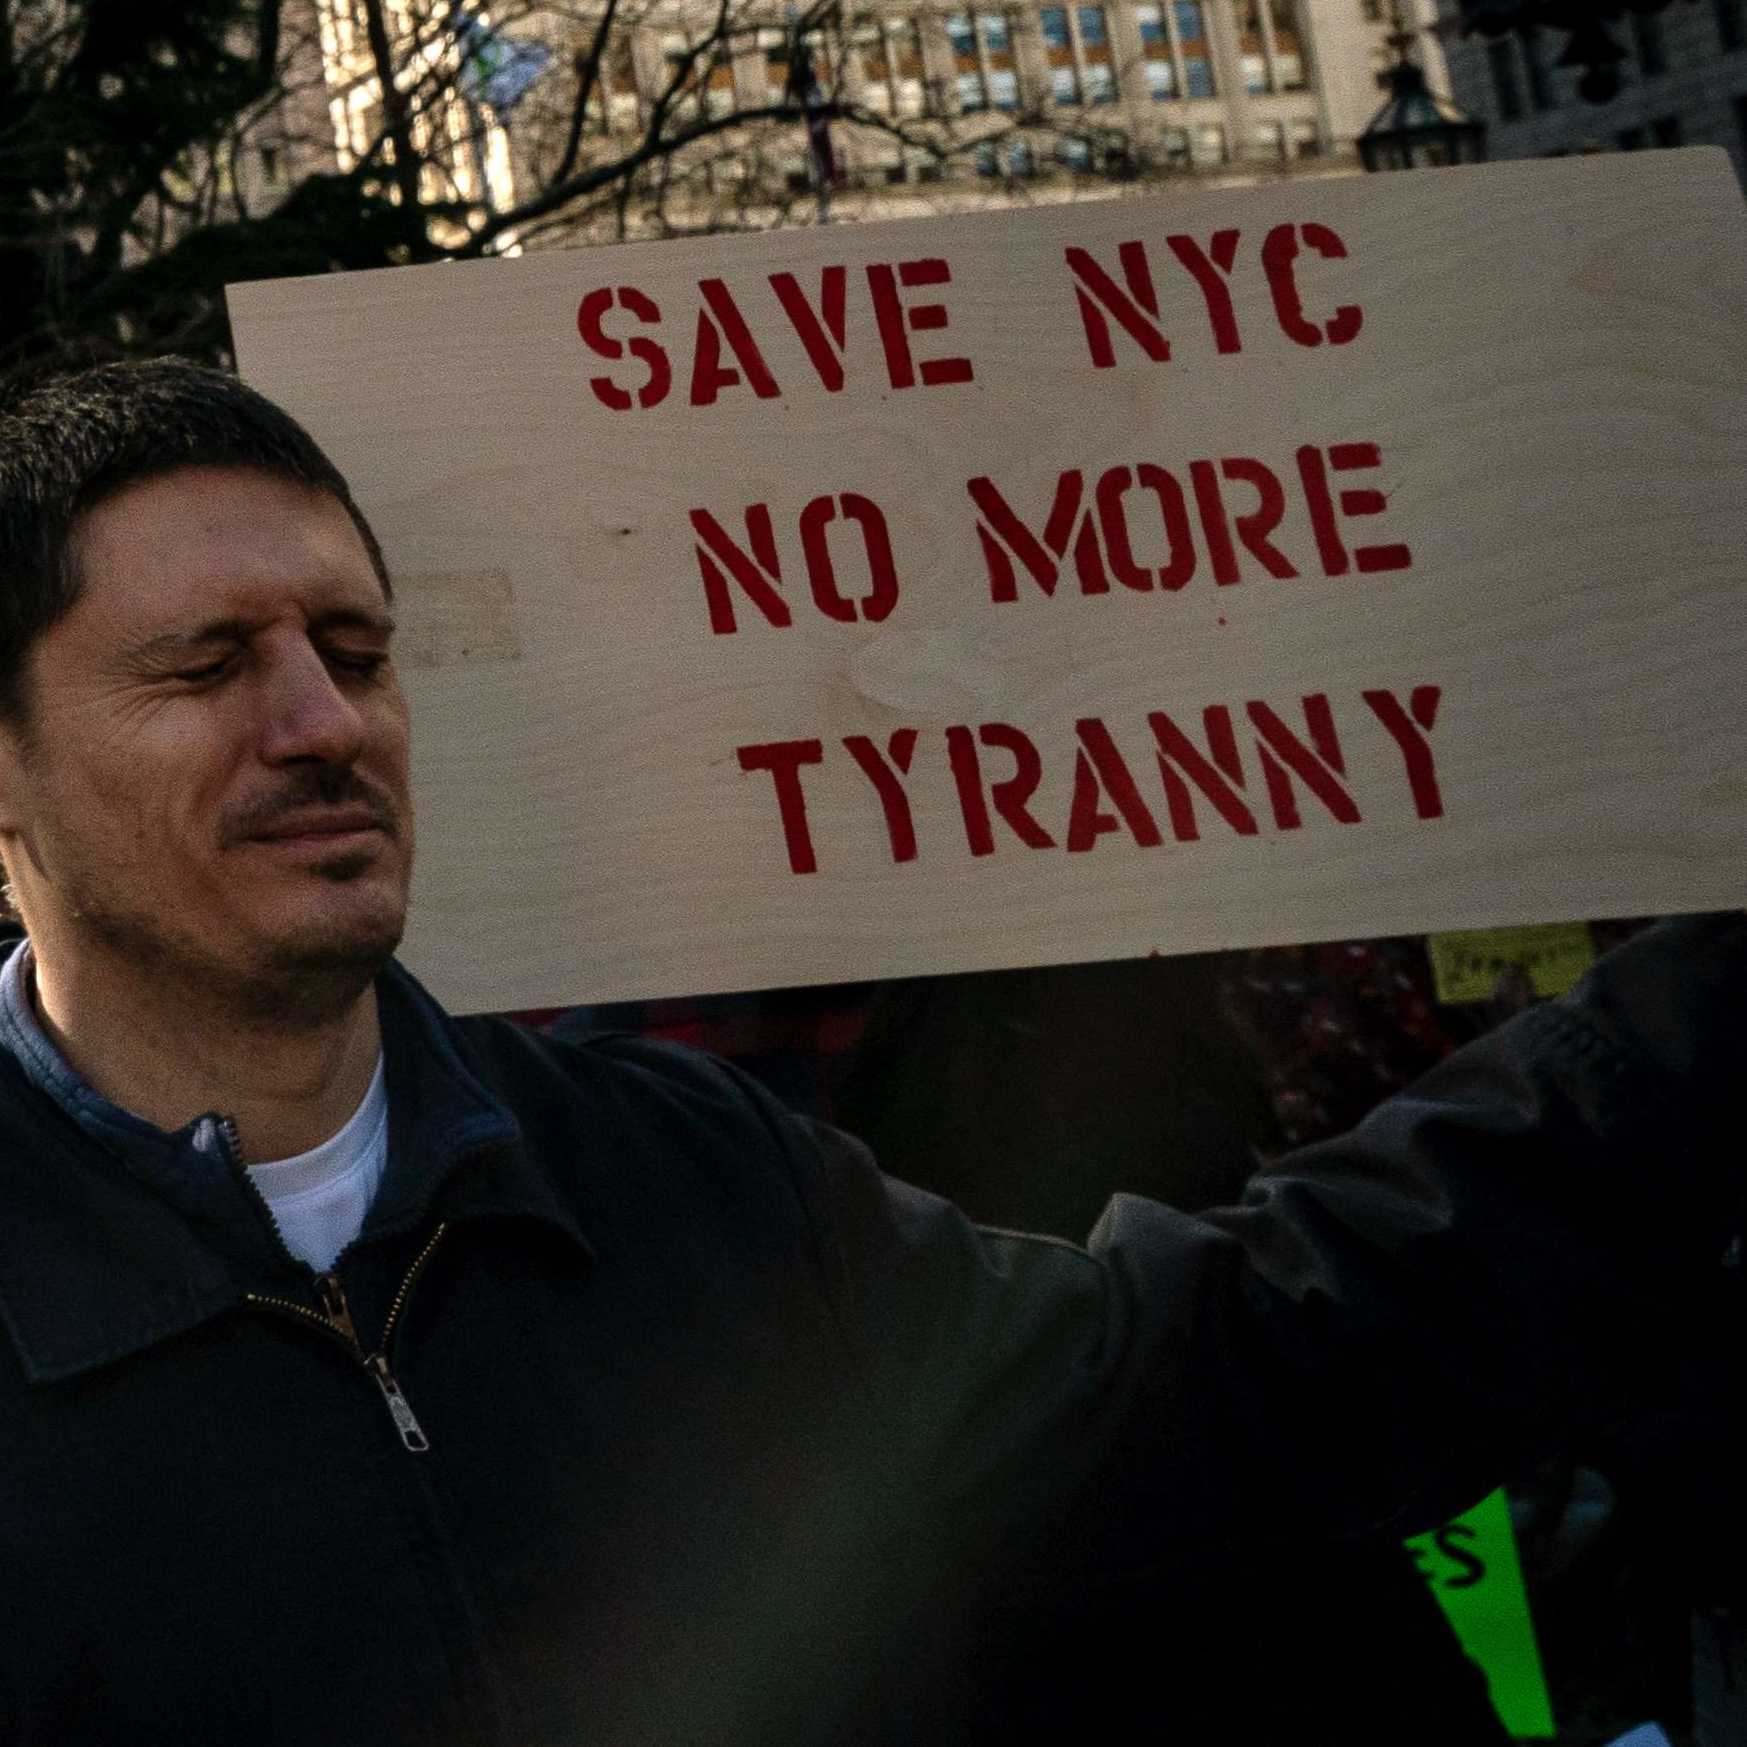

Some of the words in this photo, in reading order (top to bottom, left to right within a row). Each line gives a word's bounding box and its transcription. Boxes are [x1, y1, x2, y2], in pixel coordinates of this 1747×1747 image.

[578, 261, 971, 411] SAVE
[1068, 226, 1361, 368] NYC
[691, 494, 898, 634] NO
[967, 443, 1409, 602] MORE
[738, 688, 1442, 874] TYRANNY
